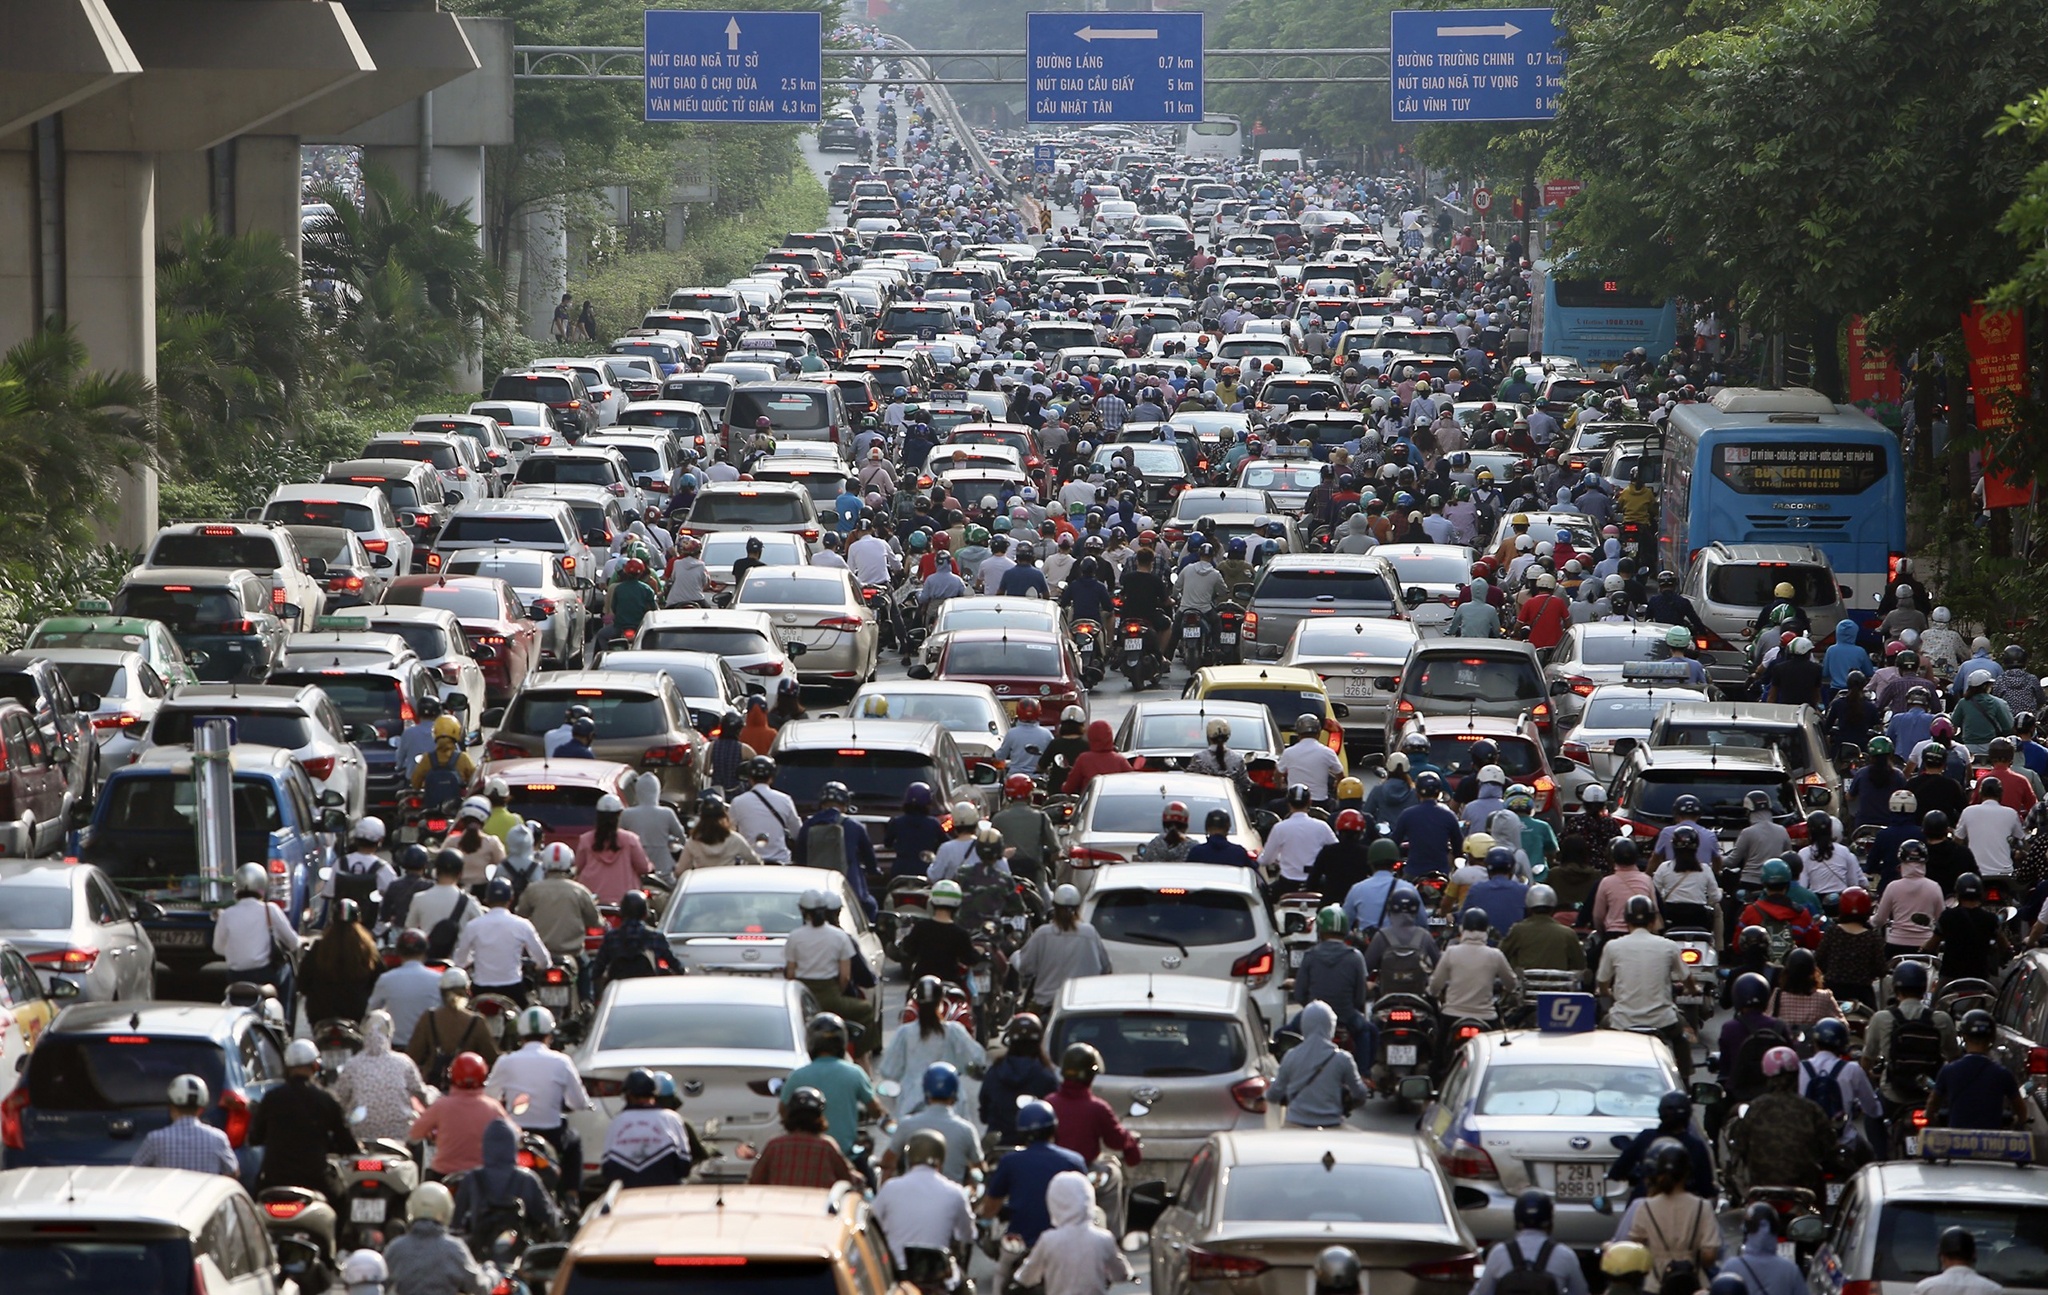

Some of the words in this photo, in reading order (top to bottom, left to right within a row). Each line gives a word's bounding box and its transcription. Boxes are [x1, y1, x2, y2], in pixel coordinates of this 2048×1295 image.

[650, 50, 670, 67] NÚT
[674, 54, 696, 67] GIAO
[701, 52, 722, 67] NGÃ
[726, 54, 740, 67] TƯ
[1036, 52, 1072, 68] ĐƯỜNG
[1076, 52, 1103, 68] LÁNG
[1178, 56, 1194, 68] km
[1398, 50, 1433, 66] ĐƯỜNG
[1438, 50, 1479, 66] TRƯỜNG
[1483, 53, 1514, 66] CHINH
[650, 73, 670, 90] NÚT
[674, 77, 696, 90] GIAO
[712, 77, 733, 92] CHỢ
[736, 74, 757, 90] DỪA
[800, 78, 816, 90] km
[1036, 74, 1056, 90] NÚT
[1060, 78, 1084, 90] GIAO
[1088, 74, 1108, 91] CẦU
[1112, 74, 1134, 91] GIẤY
[1168, 78, 1174, 90] 5
[1178, 78, 1194, 90] km
[1398, 73, 1418, 90] NÚT
[1422, 76, 1444, 89] GIAO
[1448, 74, 1469, 88] NGÃ
[1472, 76, 1487, 88] TƯ
[1490, 75, 1518, 90] VỌNG
[1536, 75, 1542, 87] 3
[1546, 75, 1562, 86] km
[650, 96, 670, 112] VĂN
[674, 95, 698, 112] MIẾU
[702, 95, 728, 112] QUỐC
[749, 96, 774, 112] GIÁM
[800, 100, 816, 112] km
[1036, 97, 1056, 114] CẦU
[1060, 98, 1086, 115] NHẬT
[1092, 98, 1112, 114] TÂN
[1164, 101, 1174, 113] 11
[1178, 101, 1194, 113] km
[1398, 95, 1418, 112] CẦU
[1422, 96, 1446, 112] VĨNH
[1452, 98, 1470, 111] TUY
[1536, 98, 1542, 110] 8
[1727, 448, 1749, 462] 21B
[1351, 678, 1366, 686] 20A
[1551, 998, 1582, 1027] G7
[1568, 1166, 1593, 1180] 29A
